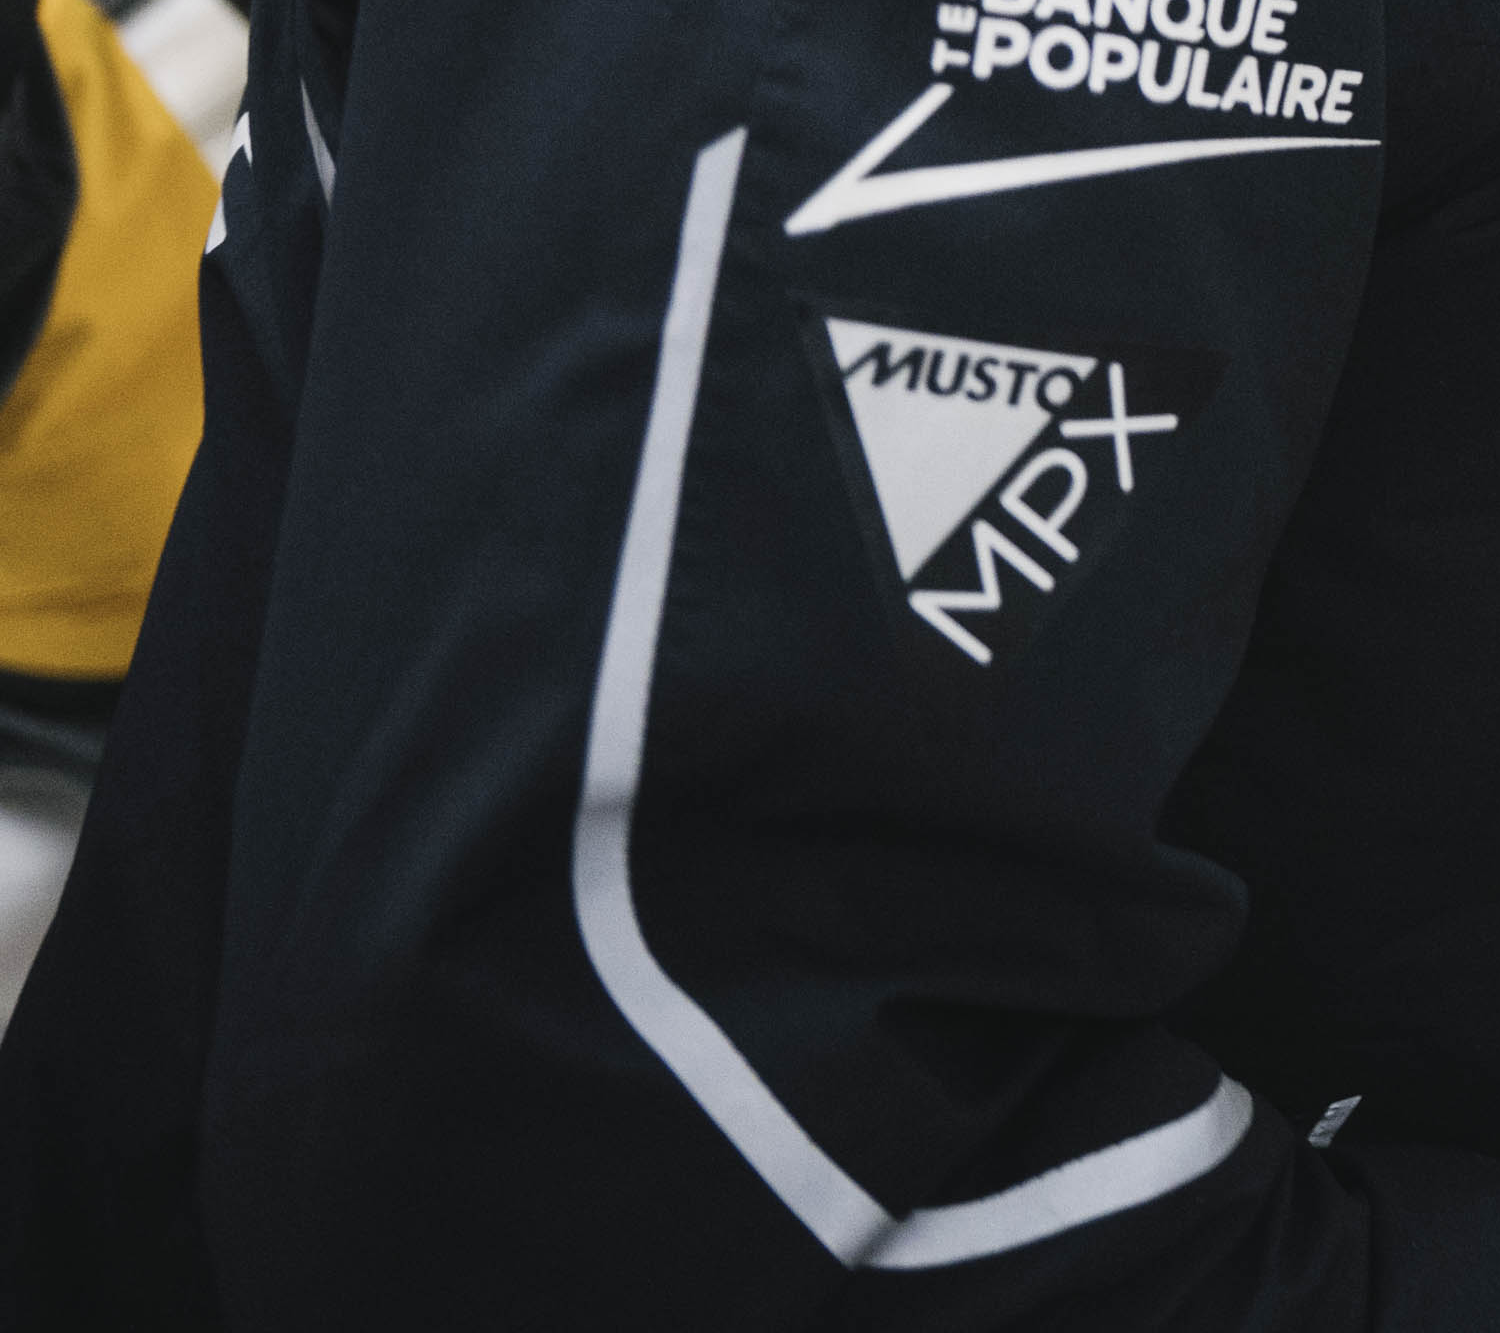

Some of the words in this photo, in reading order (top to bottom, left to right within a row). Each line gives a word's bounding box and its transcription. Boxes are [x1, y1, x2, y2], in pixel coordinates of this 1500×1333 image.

[972, 15, 1365, 126] POPULAIRE
[845, 340, 1084, 415] MUSTO
[907, 361, 1180, 666] MPX
